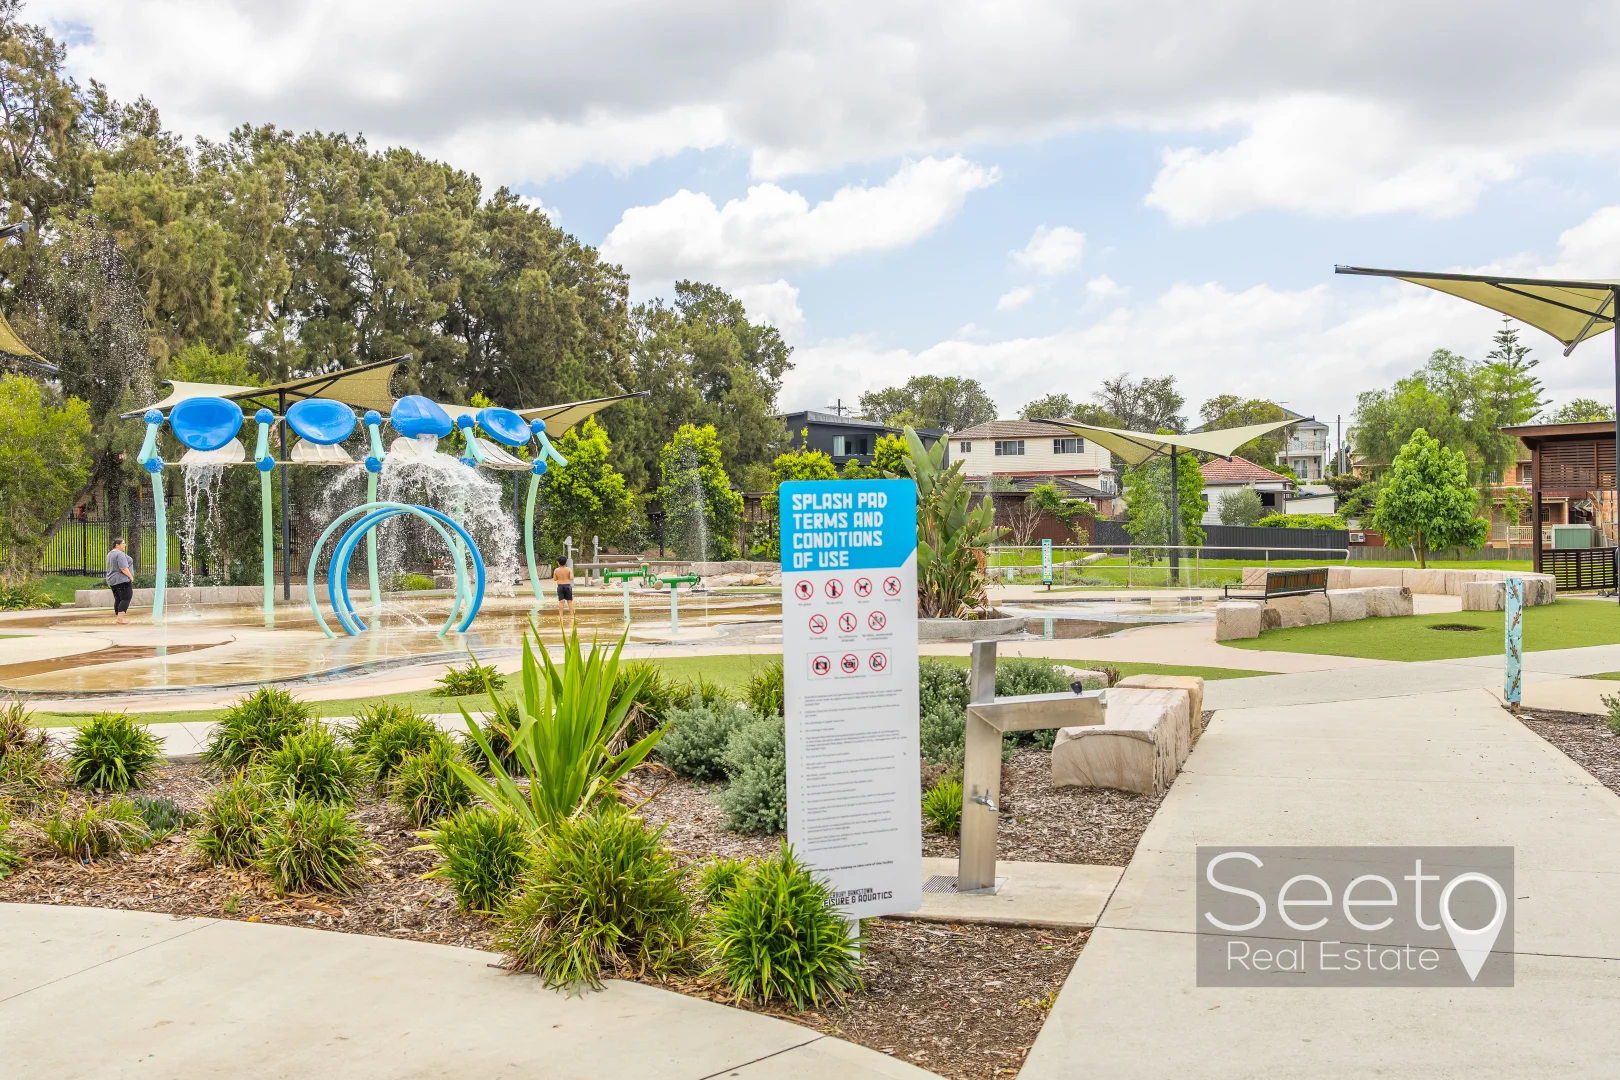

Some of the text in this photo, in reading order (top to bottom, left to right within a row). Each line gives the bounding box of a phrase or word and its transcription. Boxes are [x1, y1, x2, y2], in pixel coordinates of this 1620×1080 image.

[792, 492, 888, 511] SPLASH PAD
[792, 511, 884, 530] TERMS AND
[793, 530, 883, 549] CONDITIONS
[793, 550, 849, 569] OF USE
[822, 890, 893, 908] EISURE & AQUATICS
